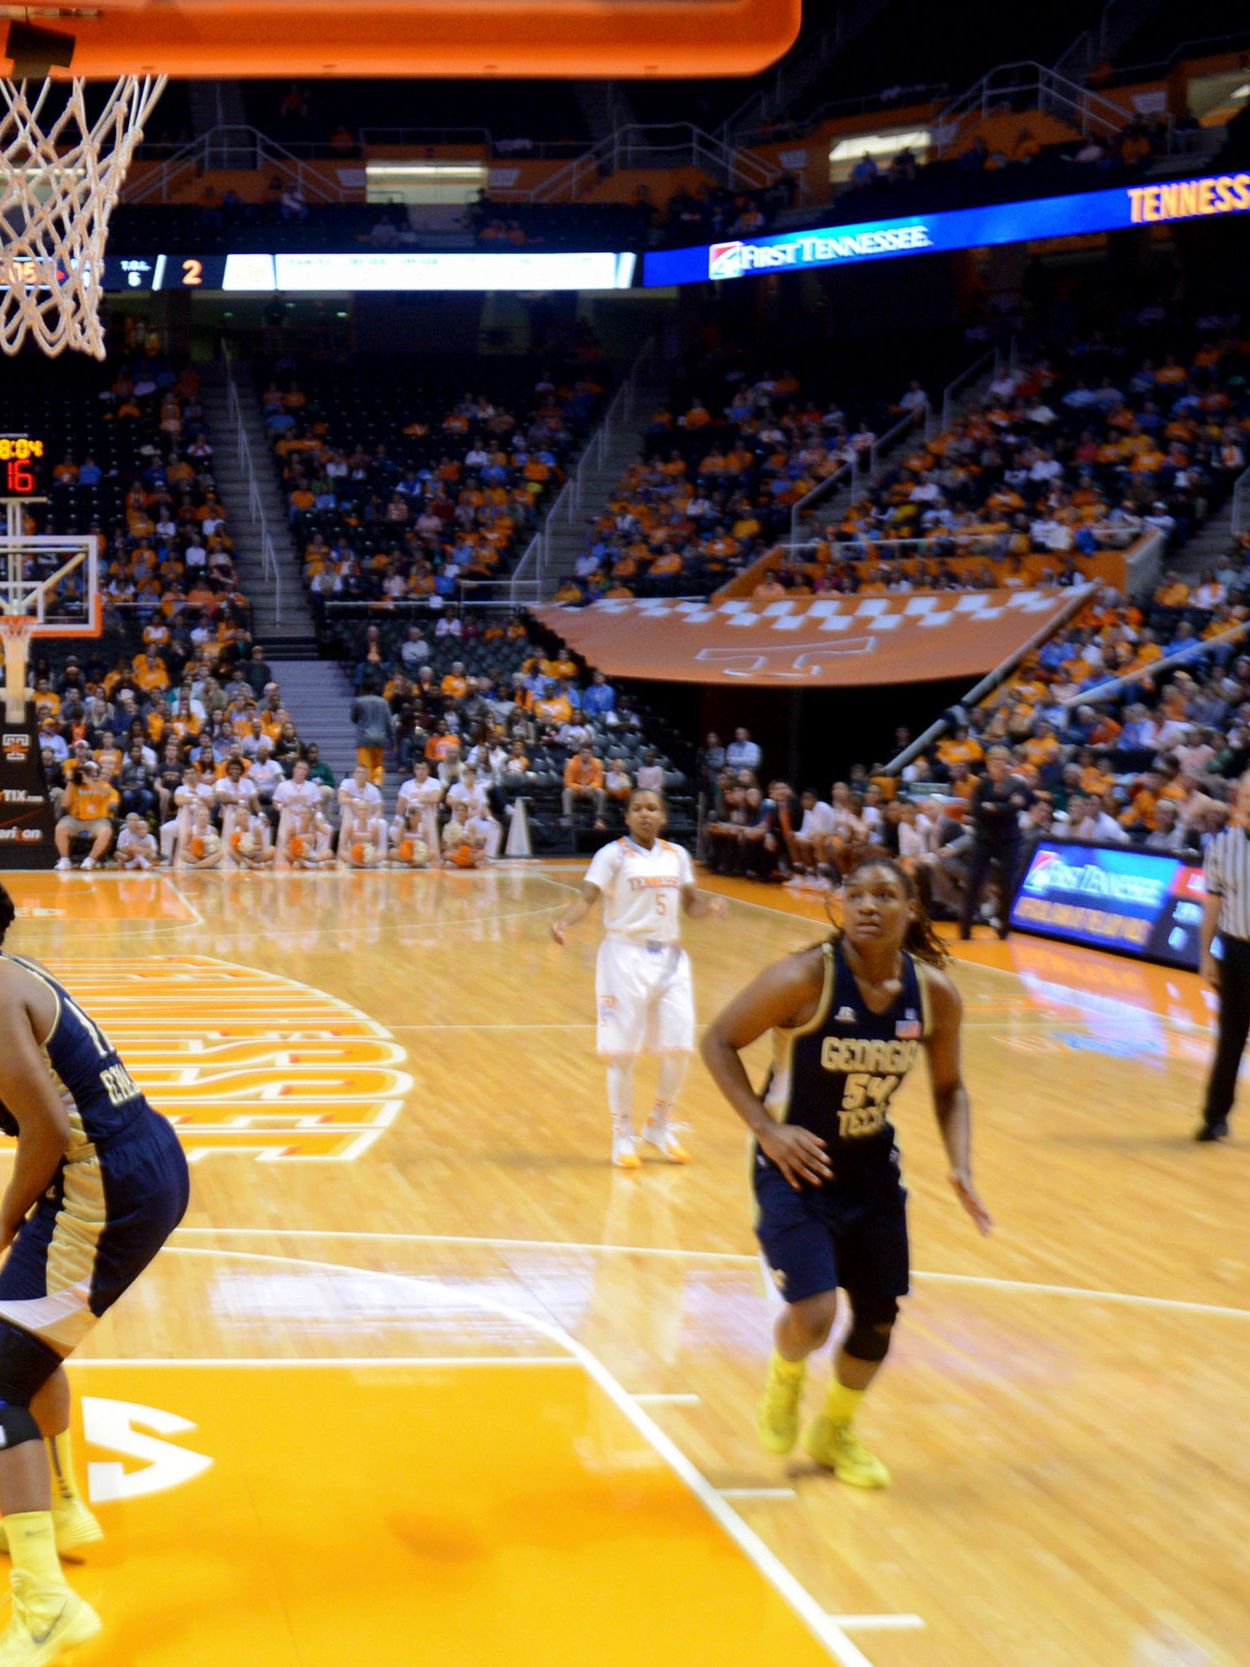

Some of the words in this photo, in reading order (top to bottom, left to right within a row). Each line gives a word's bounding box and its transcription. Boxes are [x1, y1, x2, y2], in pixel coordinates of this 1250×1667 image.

[742, 243, 798, 269] FIRST
[796, 225, 933, 261] TENNESSEE
[182, 259, 202, 285] 2
[7, 459, 35, 492] 16
[655, 893, 666, 916] 5
[842, 1073, 899, 1110] 54
